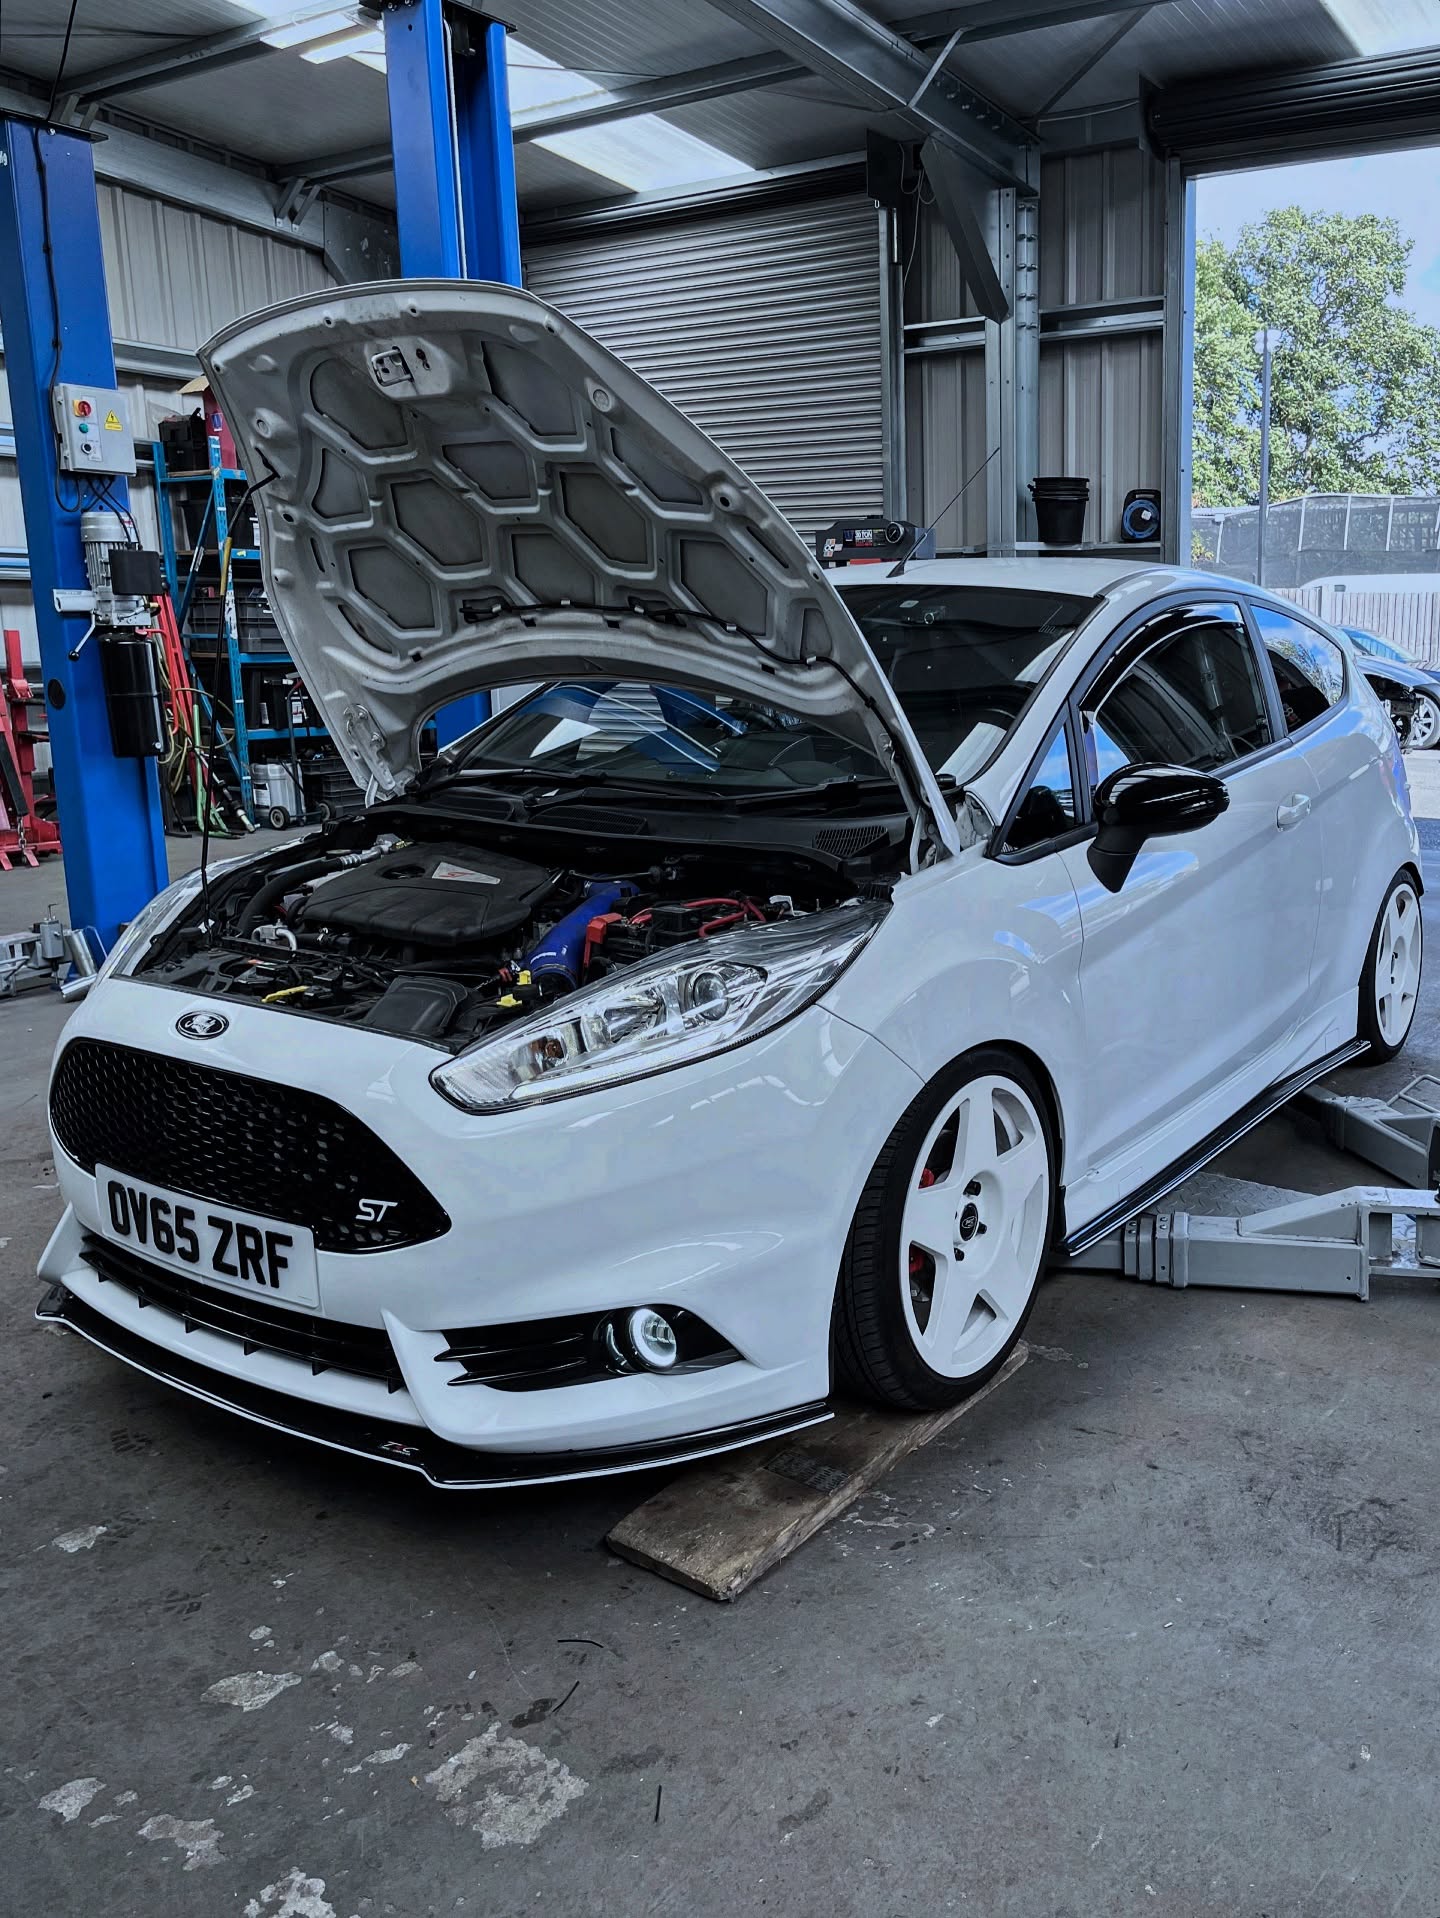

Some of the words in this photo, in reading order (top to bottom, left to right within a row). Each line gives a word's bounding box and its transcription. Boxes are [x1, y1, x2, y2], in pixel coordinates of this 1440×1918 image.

[107, 1180, 200, 1263] OV65
[207, 1215, 294, 1288] ZRF
[355, 1198, 399, 1222] ST
